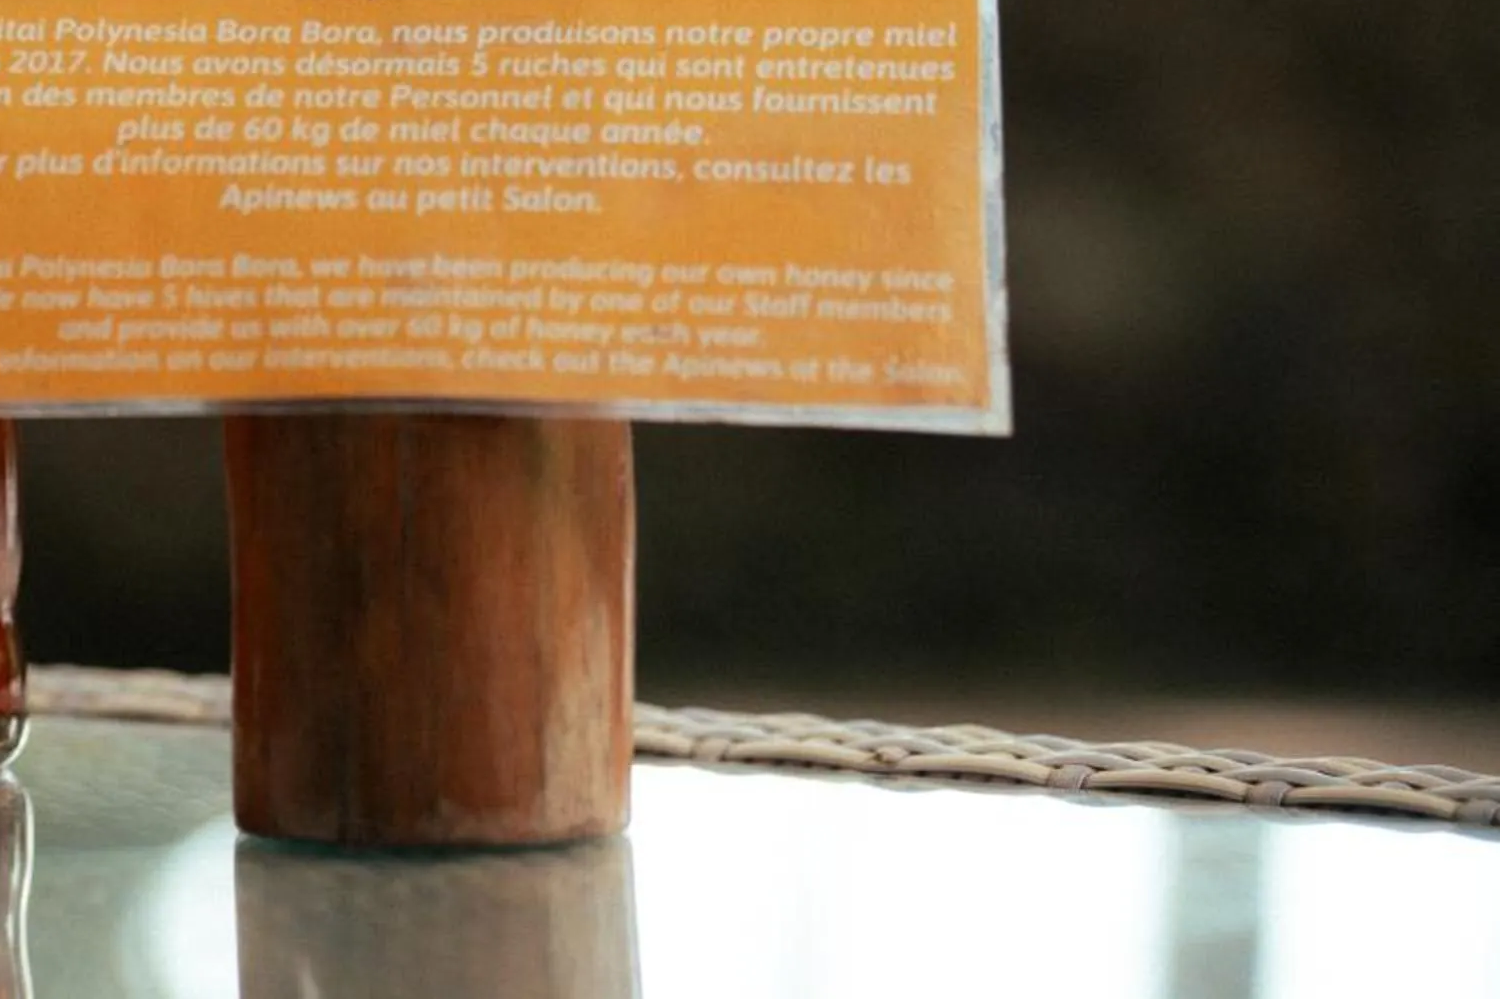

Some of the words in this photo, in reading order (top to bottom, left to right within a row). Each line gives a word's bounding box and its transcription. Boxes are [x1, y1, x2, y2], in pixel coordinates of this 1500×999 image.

[55, 18, 208, 48] Polynesia
[216, 19, 292, 44] Bora
[300, 20, 384, 48] Bora,
[391, 23, 468, 46] nous
[477, 21, 657, 51] produisons
[664, 24, 753, 46] notre
[762, 25, 874, 54] propre
[883, 22, 959, 48] miel
[8, 50, 93, 74] 2017.
[103, 51, 184, 74] Nous
[192, 55, 285, 76] avons
[295, 50, 461, 77] désormais
[471, 54, 489, 78] 5
[499, 54, 607, 79] ruches
[615, 56, 667, 85] qui
[675, 57, 745, 80] sont
[755, 58, 957, 83] entretenues
[22, 82, 76, 107] des
[86, 83, 237, 108] membres
[244, 83, 284, 109] de
[293, 88, 379, 110] notre
[389, 83, 552, 111] Personnel
[560, 89, 594, 111] et
[603, 88, 656, 118] qui
[664, 91, 743, 113] nous
[752, 87, 937, 116] fournissent
[117, 117, 186, 145] plus
[194, 117, 235, 140] de
[243, 117, 284, 141] 60
[292, 117, 330, 148] kg
[340, 119, 379, 142] de
[389, 118, 461, 142] miel
[469, 119, 591, 149] chaque
[600, 120, 710, 147] année.
[15, 149, 84, 179] plus
[335, 154, 387, 177] sur
[393, 154, 450, 177] nos
[460, 153, 685, 184] interventions,
[693, 158, 855, 184] consultez
[864, 158, 912, 185] les
[219, 183, 358, 215] Apinews
[366, 189, 409, 211] au
[416, 184, 495, 218] petit
[503, 186, 602, 214] Salon.
